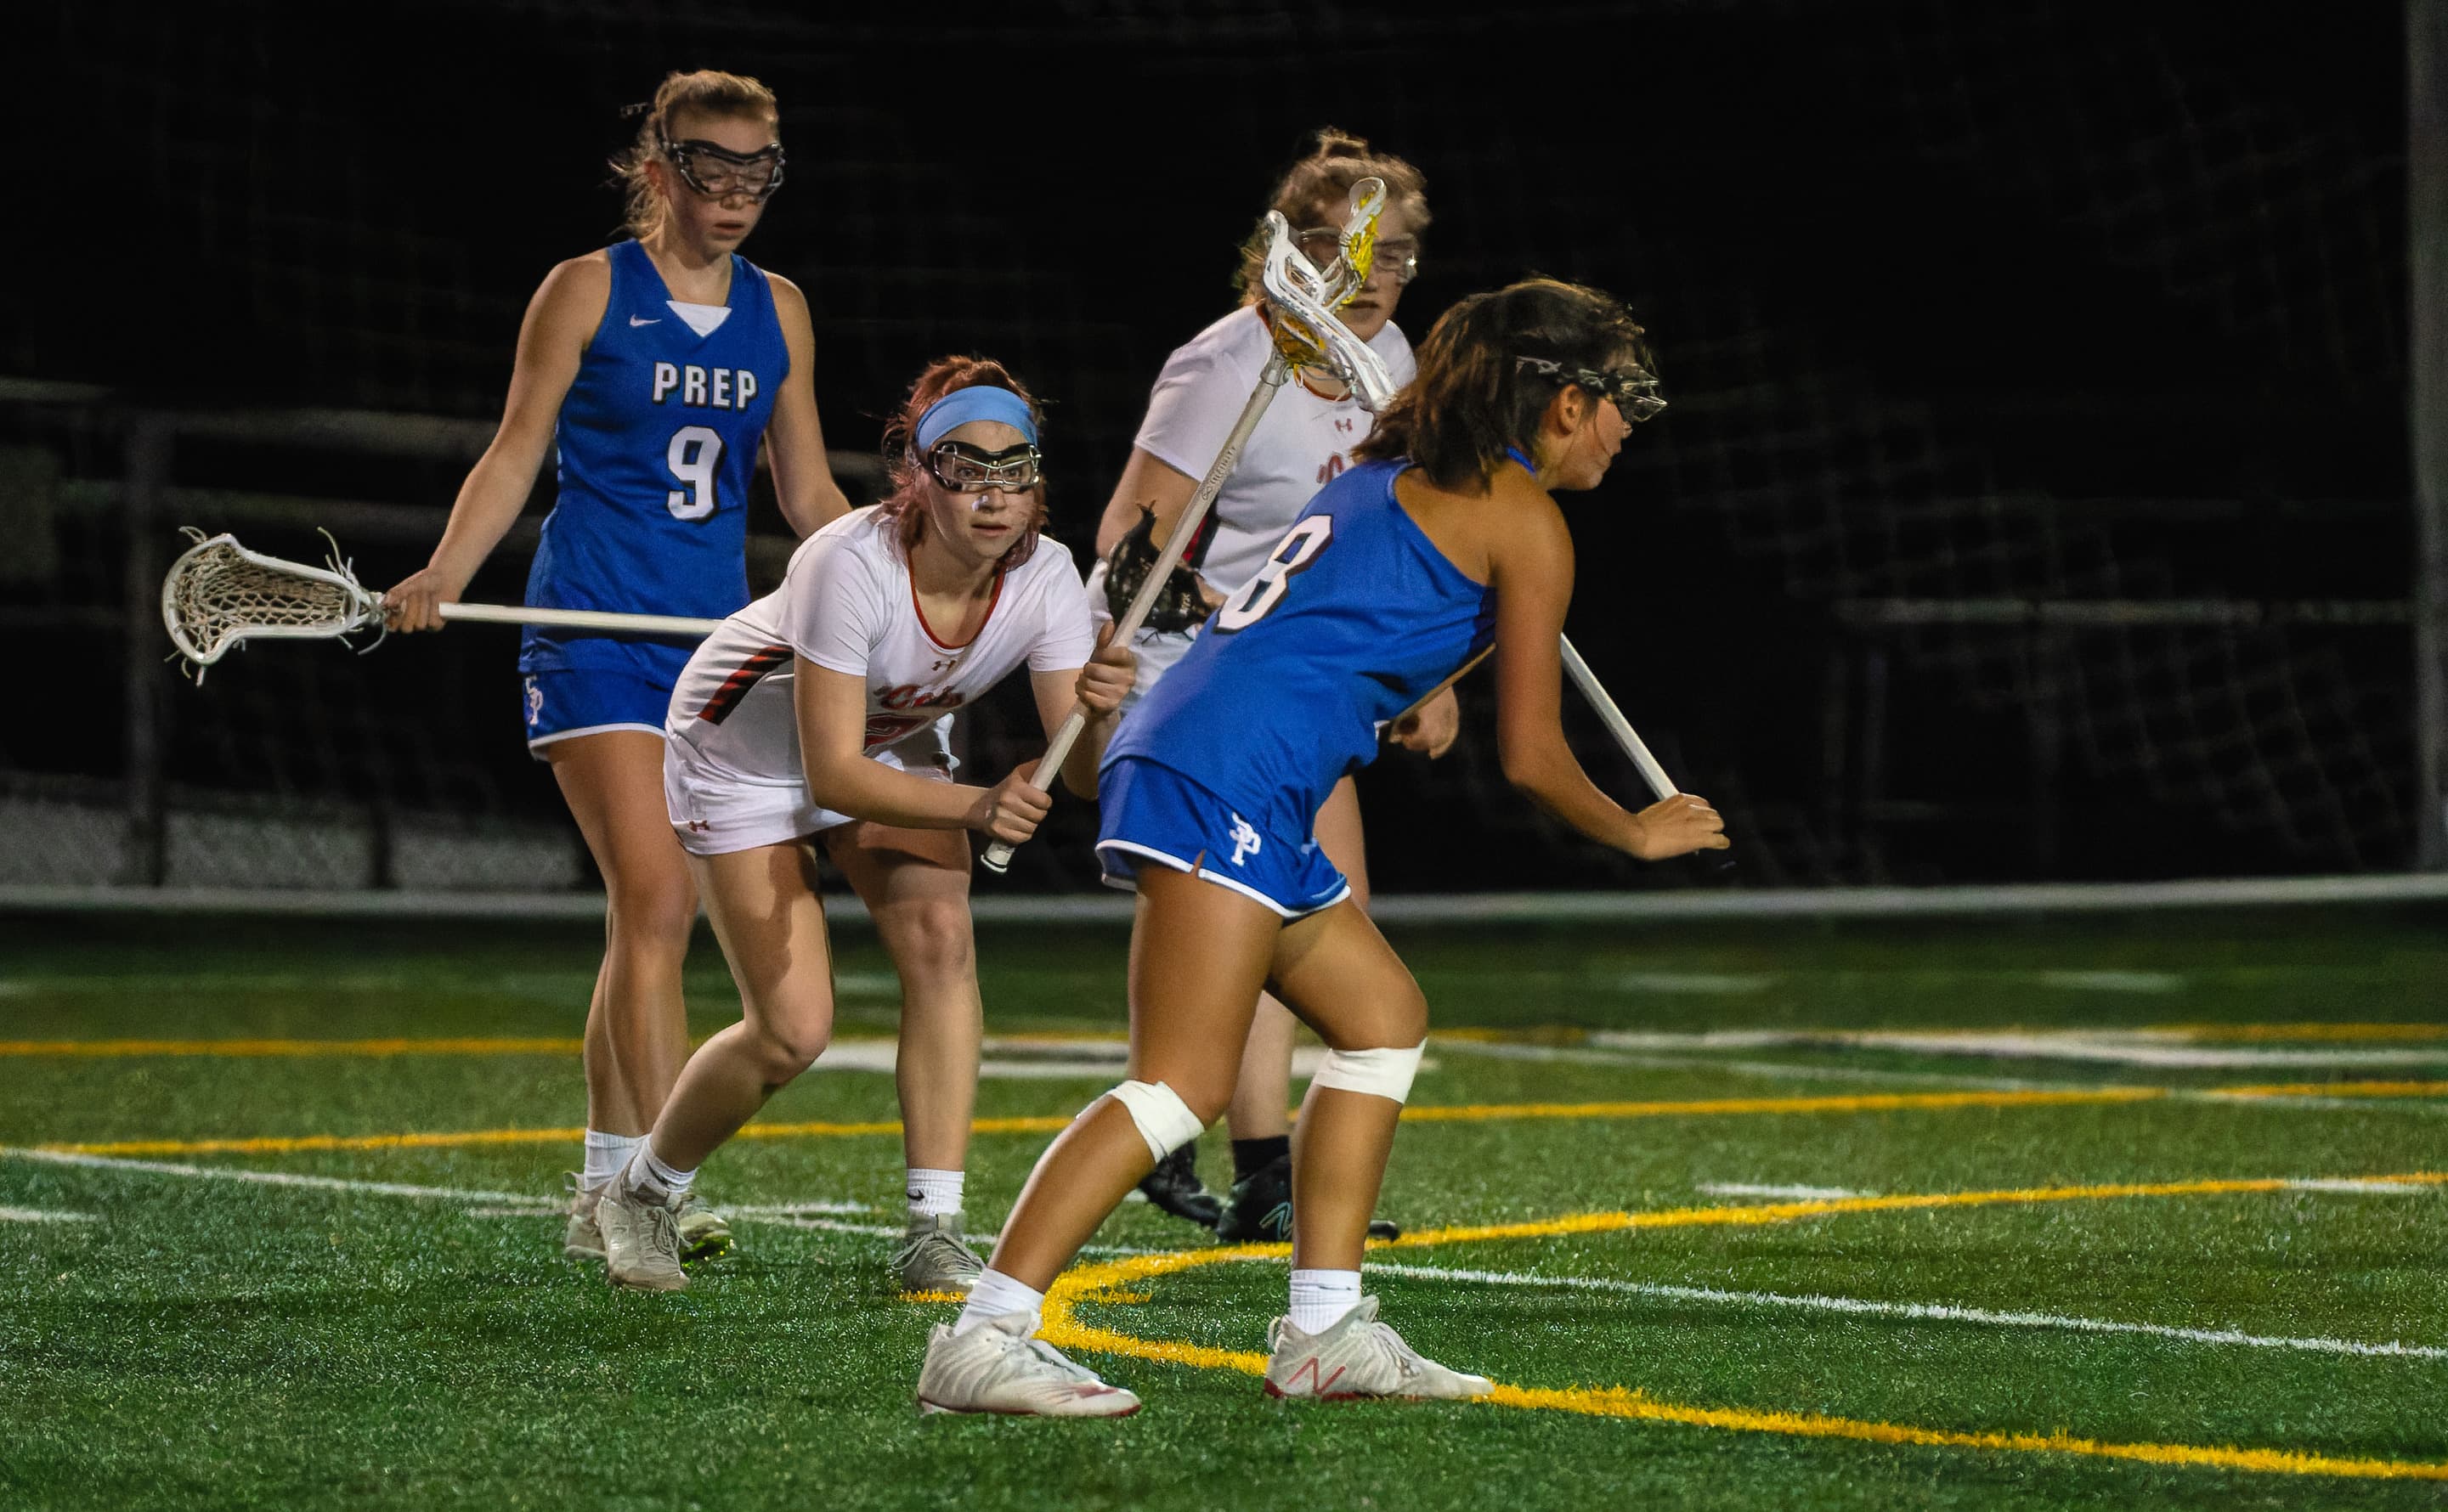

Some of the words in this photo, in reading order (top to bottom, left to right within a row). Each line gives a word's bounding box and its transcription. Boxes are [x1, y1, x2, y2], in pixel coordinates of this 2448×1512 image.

[653, 361, 757, 410] PREP
[668, 426, 725, 522] 9
[1215, 514, 1333, 632] 8
